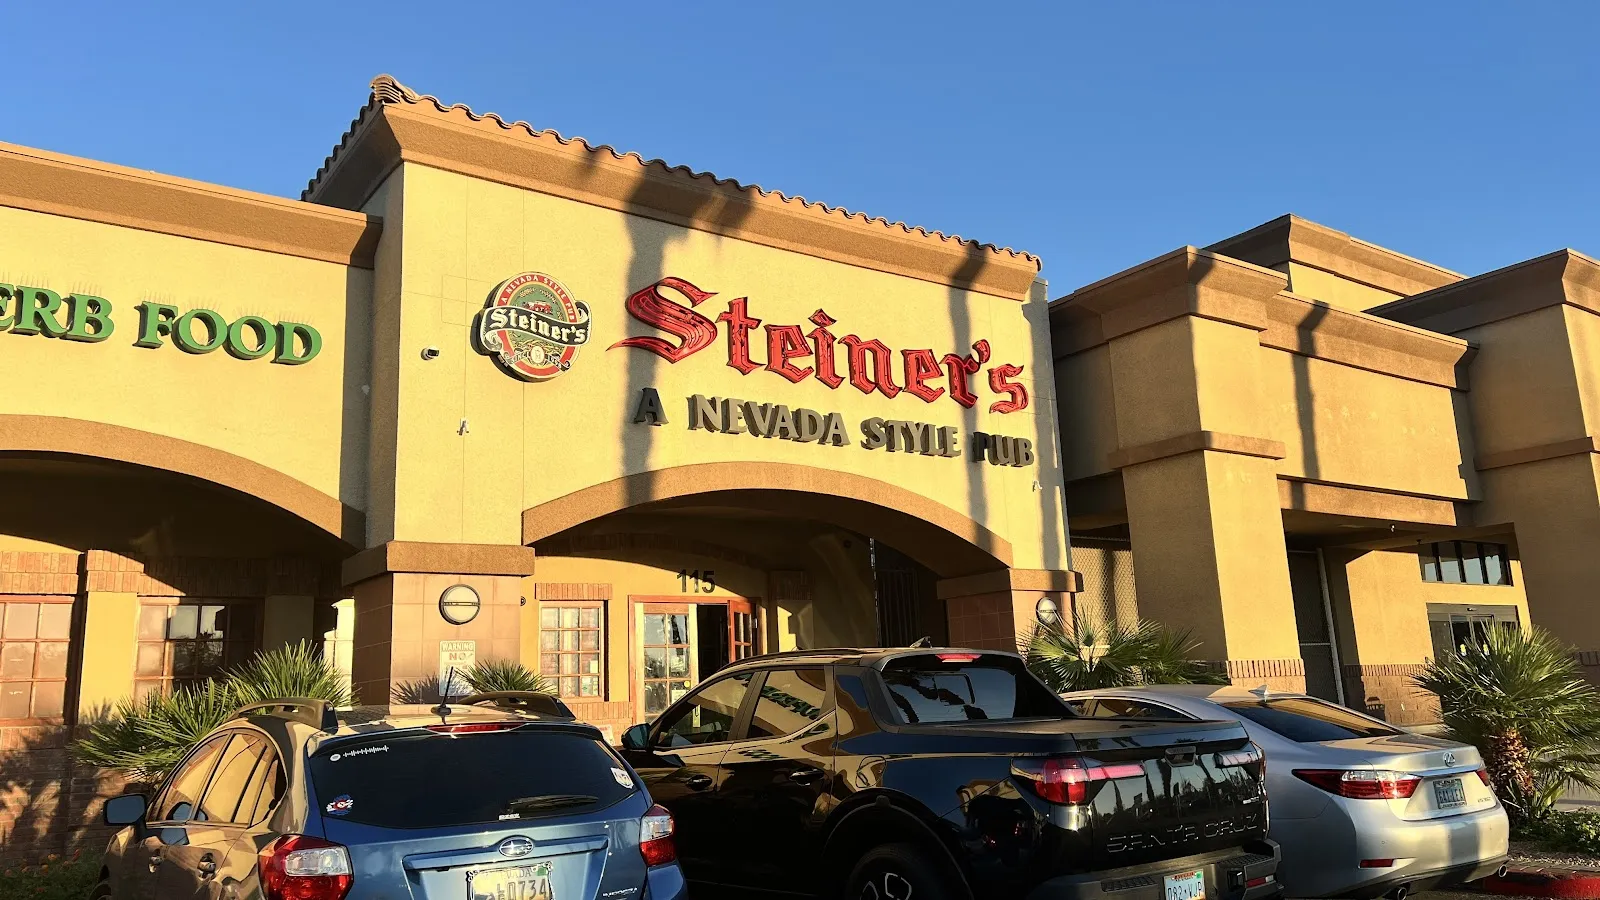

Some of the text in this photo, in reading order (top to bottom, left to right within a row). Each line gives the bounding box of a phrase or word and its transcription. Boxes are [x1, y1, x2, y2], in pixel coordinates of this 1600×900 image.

[505, 275, 539, 295] NEVADA
[543, 277, 566, 300] STYLE
[566, 302, 575, 320] PUB
[132, 300, 323, 366] FOOD
[489, 308, 587, 343] Steiner's
[605, 276, 1030, 414] Steiner's
[633, 387, 1035, 467] A NEVADA STYLE PUB
[676, 568, 717, 594] 115
[441, 642, 475, 652] WARNING
[1107, 813, 1258, 853] SANTA CRUZ
